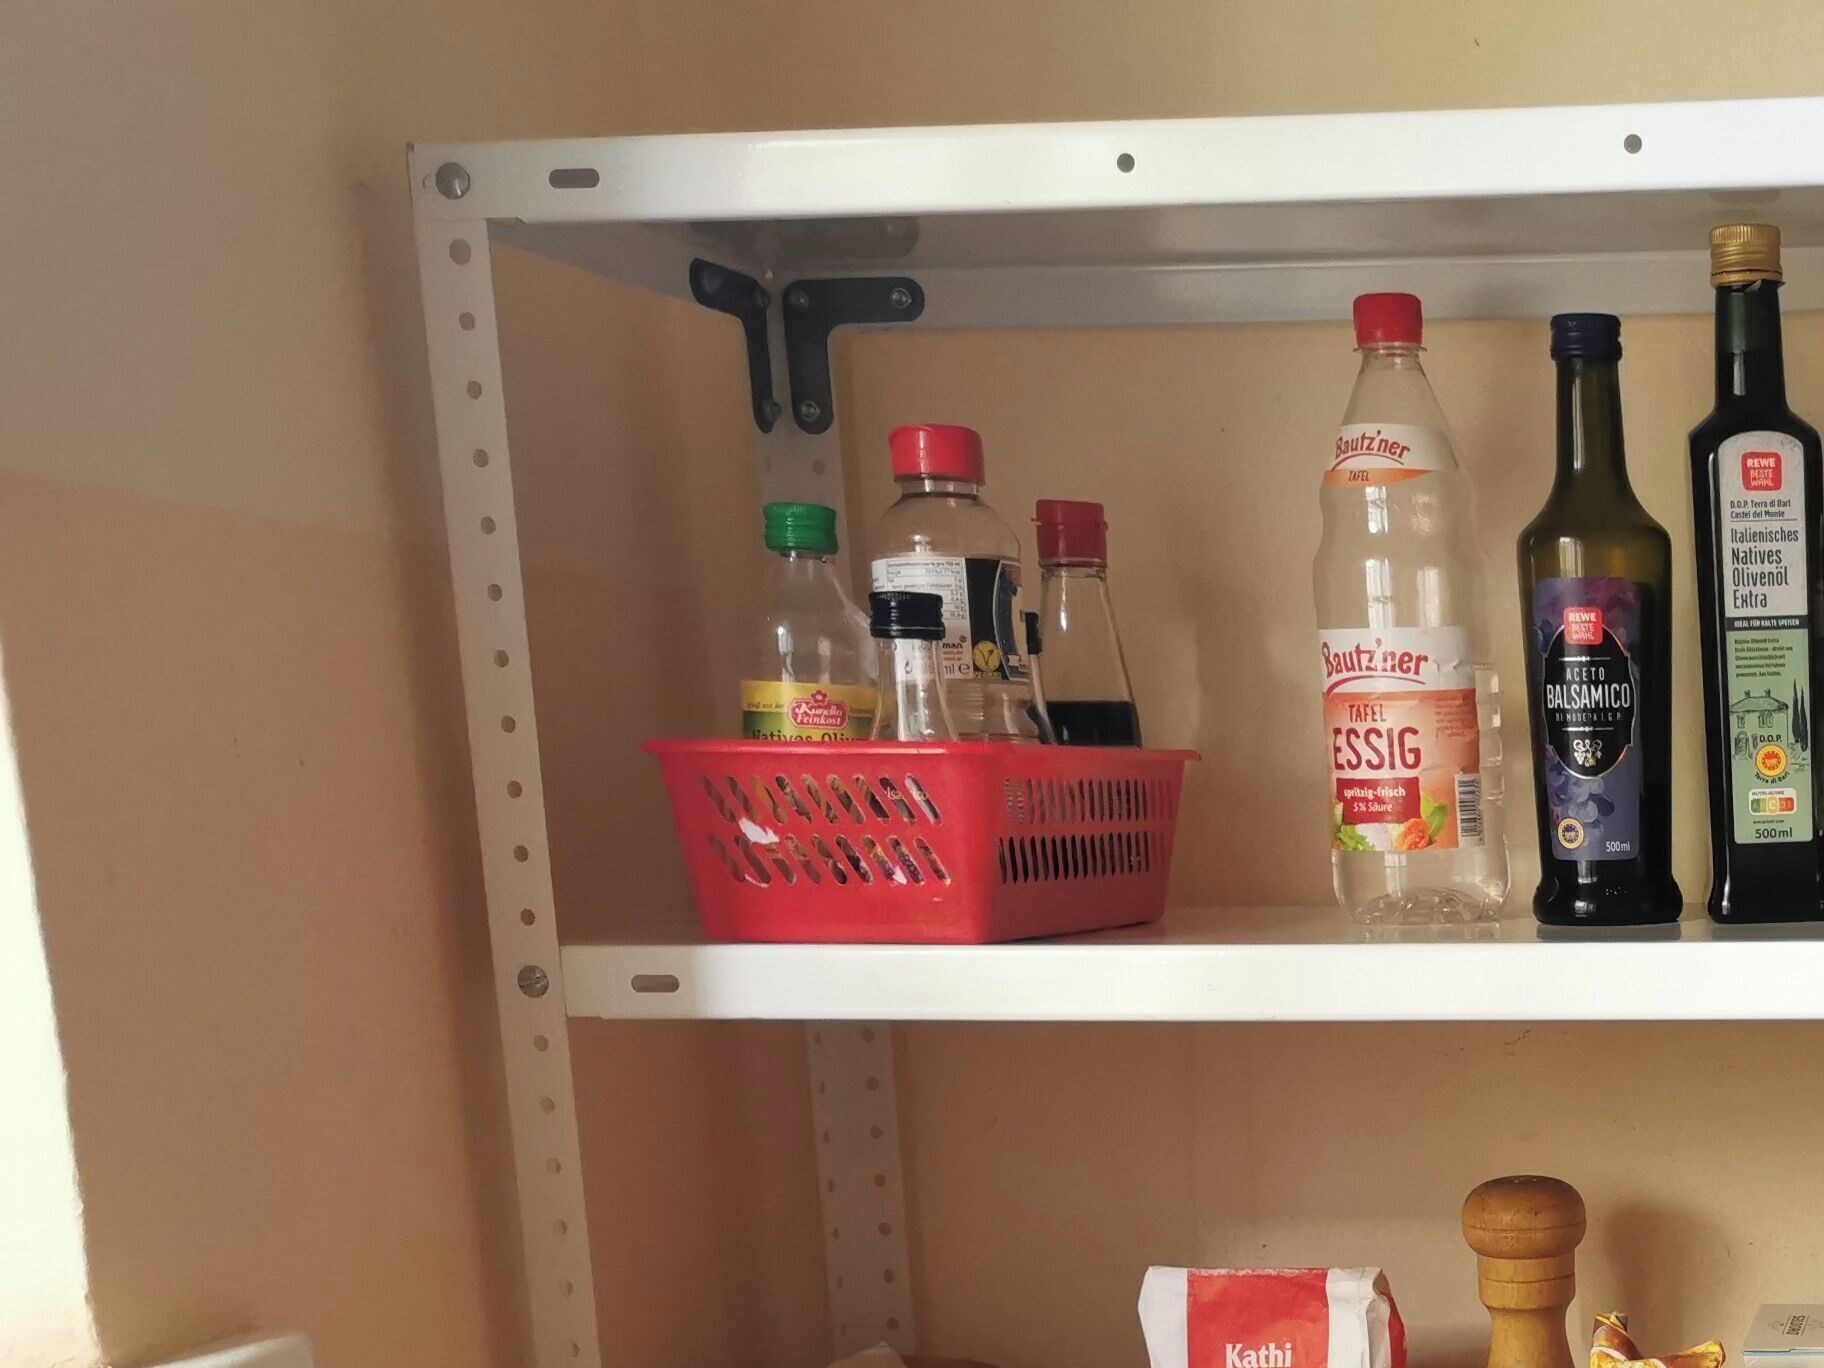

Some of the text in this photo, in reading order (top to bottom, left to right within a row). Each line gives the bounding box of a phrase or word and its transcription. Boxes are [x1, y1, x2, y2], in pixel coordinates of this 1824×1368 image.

[1335, 430, 1410, 460] Bautz'ner
[1746, 458, 1776, 468] REWE
[1348, 470, 1370, 482] TAFEL
[1751, 500, 1768, 508] Terra
[1769, 499, 1776, 508] di
[1731, 527, 1799, 544] Italienisches
[1731, 546, 1783, 566] Natives
[1732, 566, 1790, 588] Olivenöl
[1733, 589, 1768, 609] Extra
[1568, 612, 1596, 622] REWE
[1321, 638, 1429, 679] Bautz'ner
[1566, 667, 1605, 681] ACETO
[1546, 683, 1631, 709] BALSAMICO
[796, 714, 842, 726] Feinkost
[1348, 703, 1387, 723] TAFEL
[1760, 734, 1783, 743] D.O.P.
[1332, 726, 1422, 770] ESSIG
[1343, 786, 1406, 800] spritzig-frisch
[1353, 801, 1393, 812] 5% Säure
